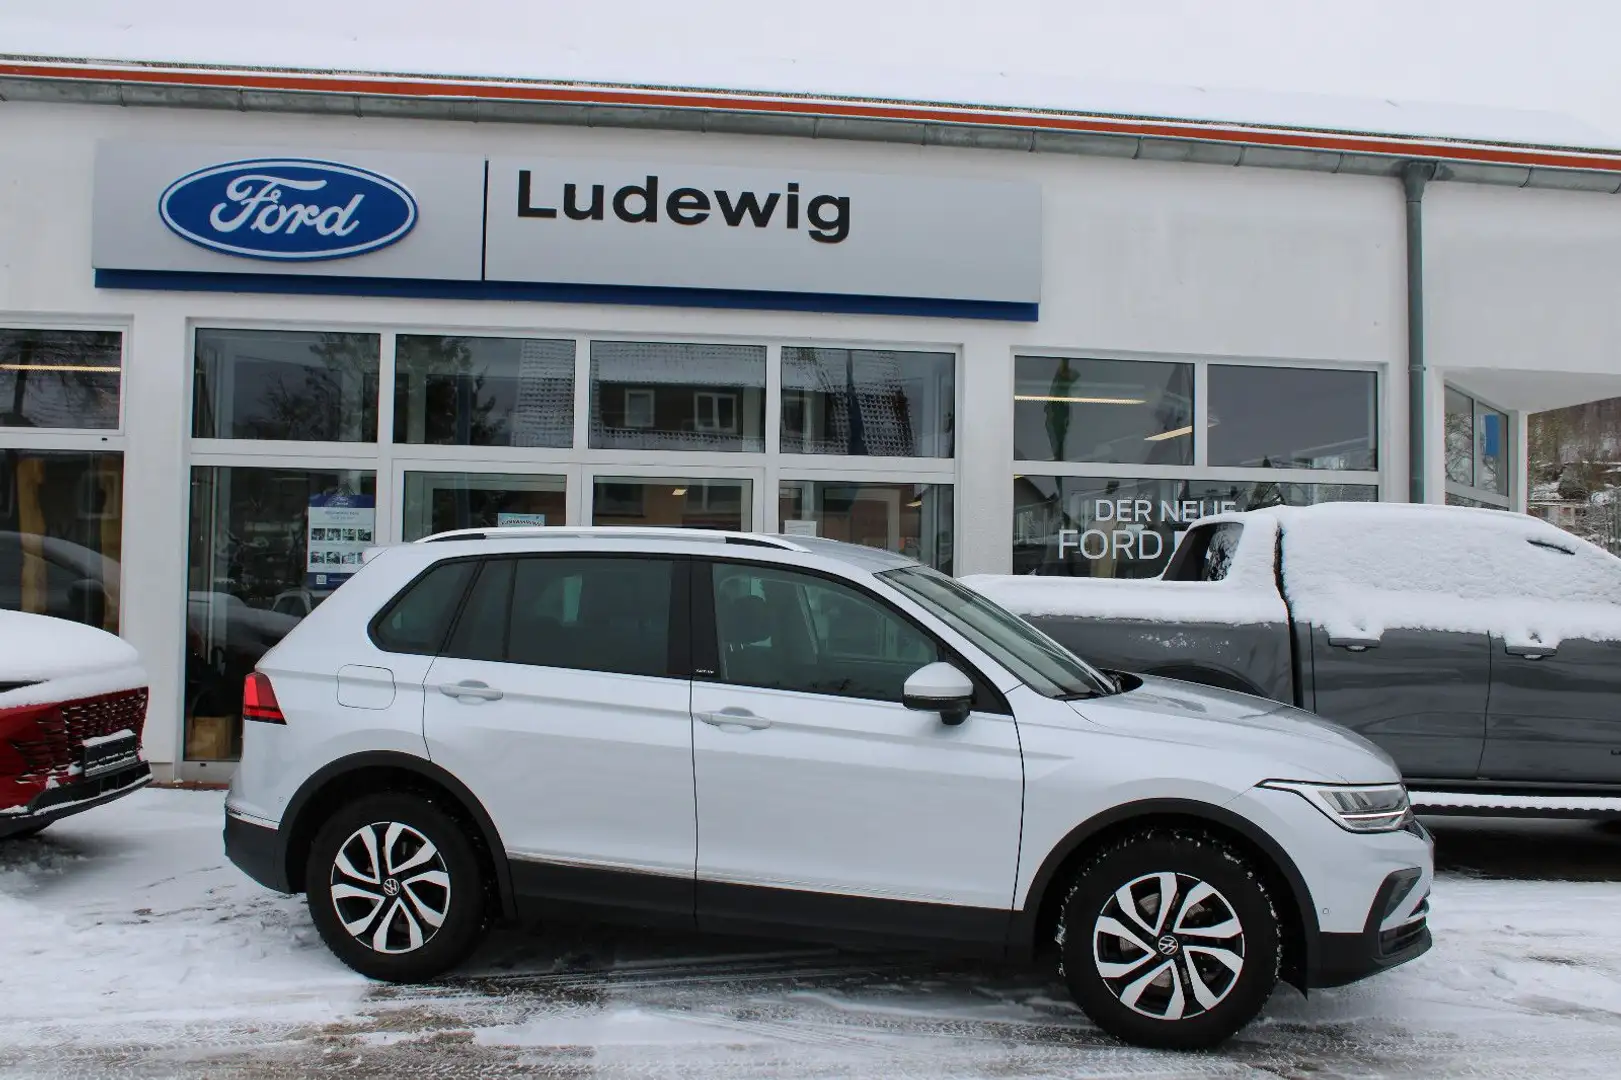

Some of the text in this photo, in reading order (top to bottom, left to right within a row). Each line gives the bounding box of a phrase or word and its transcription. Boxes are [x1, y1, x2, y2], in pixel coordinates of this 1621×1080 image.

[209, 174, 365, 237] Ford
[517, 170, 851, 244] Ludewig
[1095, 499, 1152, 522] DER
[1058, 529, 1163, 560] FORD
